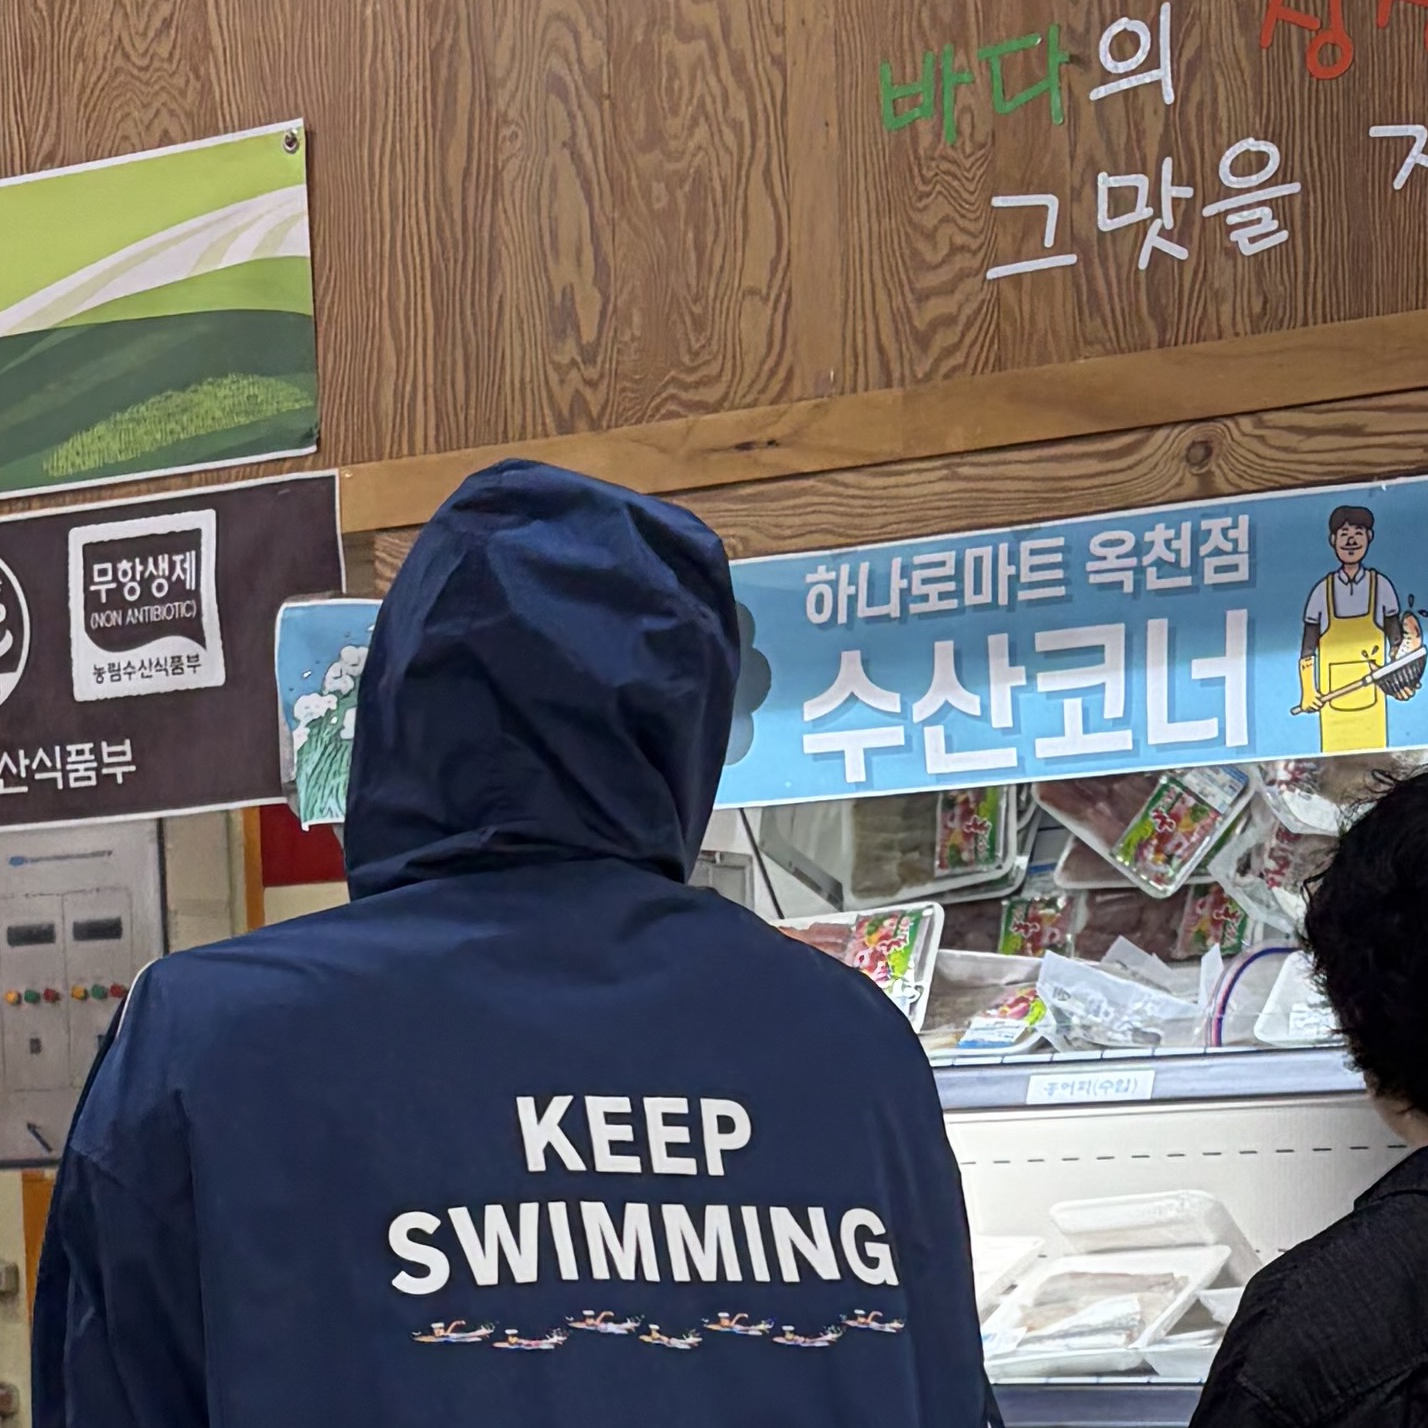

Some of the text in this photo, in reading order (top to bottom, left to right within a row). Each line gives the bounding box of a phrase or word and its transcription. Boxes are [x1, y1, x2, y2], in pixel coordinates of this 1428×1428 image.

[880, 0, 1174, 146] 바다의
[985, 137, 1301, 280] 그맛을
[89, 550, 198, 604] 무항생제
[89, 599, 198, 631] (NON ANTIBIOTIC)
[803, 512, 1251, 628] 하나로마트 옥천점
[801, 606, 1252, 785] 수산코너
[515, 1094, 753, 1176] KEEP
[387, 1200, 900, 1296] SWIMMING
